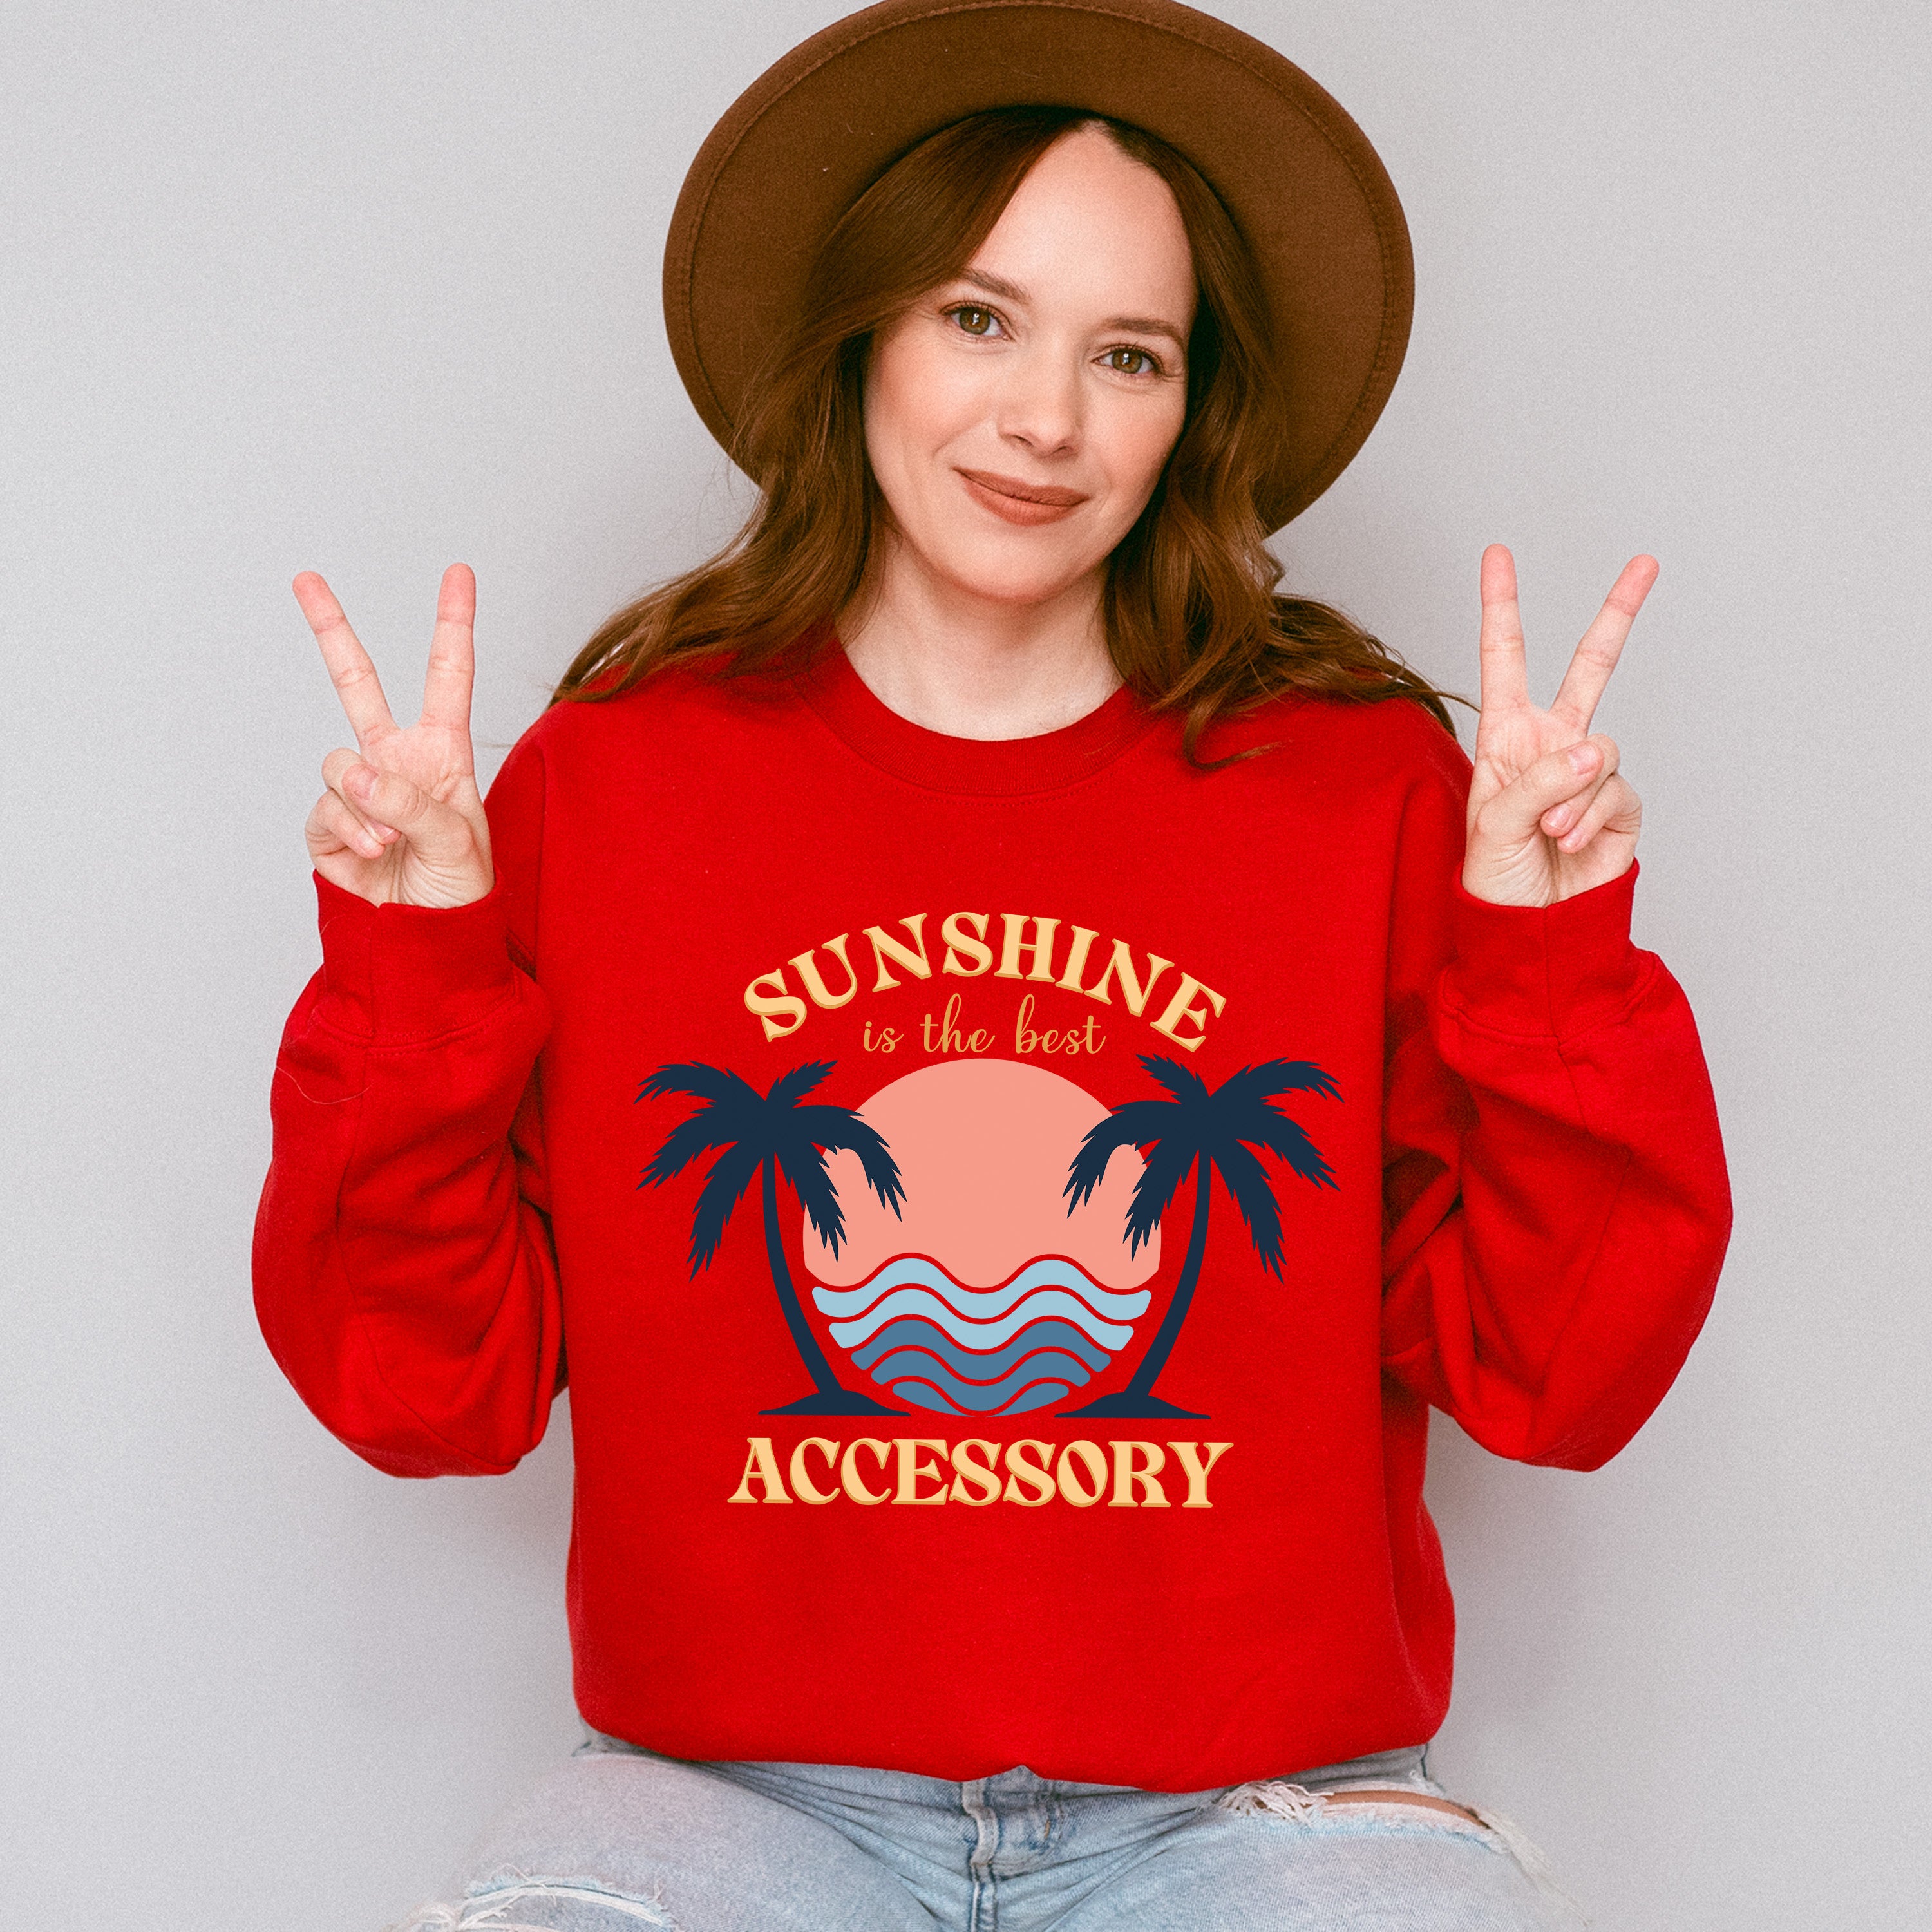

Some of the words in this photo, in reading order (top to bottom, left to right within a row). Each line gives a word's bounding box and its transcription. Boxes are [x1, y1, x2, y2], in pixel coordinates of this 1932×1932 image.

[743, 911, 1227, 1053] SUNSHINE
[863, 1021, 904, 1053] is
[920, 994, 996, 1054] the
[1015, 994, 1106, 1055] best
[727, 1437, 1234, 1508] ACCESSORY
